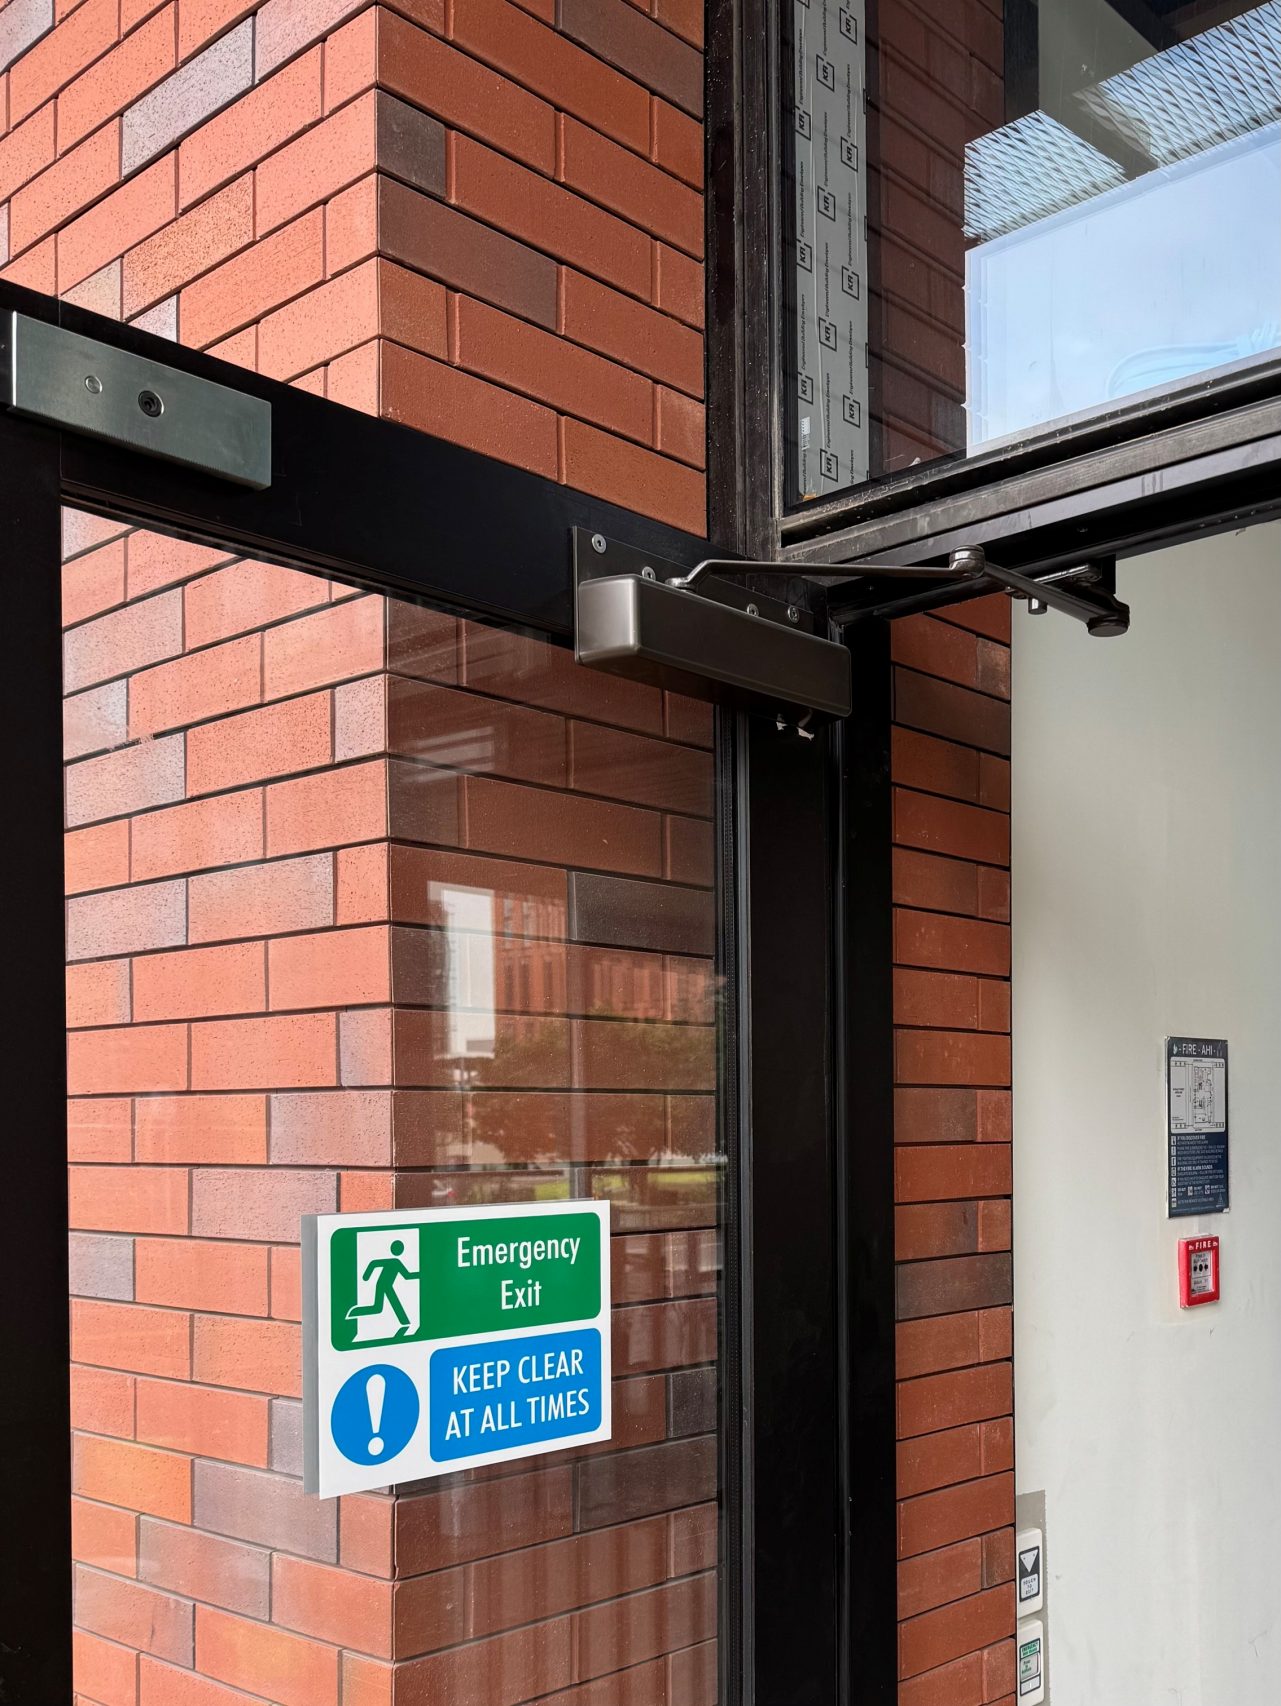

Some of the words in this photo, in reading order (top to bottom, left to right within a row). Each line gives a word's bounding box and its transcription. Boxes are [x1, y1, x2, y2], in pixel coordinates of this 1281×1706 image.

[1182, 1043, 1197, 1055] FIRE
[1201, 1044, 1213, 1056] AHI
[457, 1236, 581, 1269] Emergency
[1195, 1240, 1212, 1250] FIRE
[501, 1279, 542, 1310] Exit
[453, 1360, 510, 1395] KEEP
[518, 1349, 584, 1384] CLEAR
[445, 1408, 474, 1440] AT
[480, 1401, 522, 1434] ALL
[526, 1388, 590, 1424] TIMES
